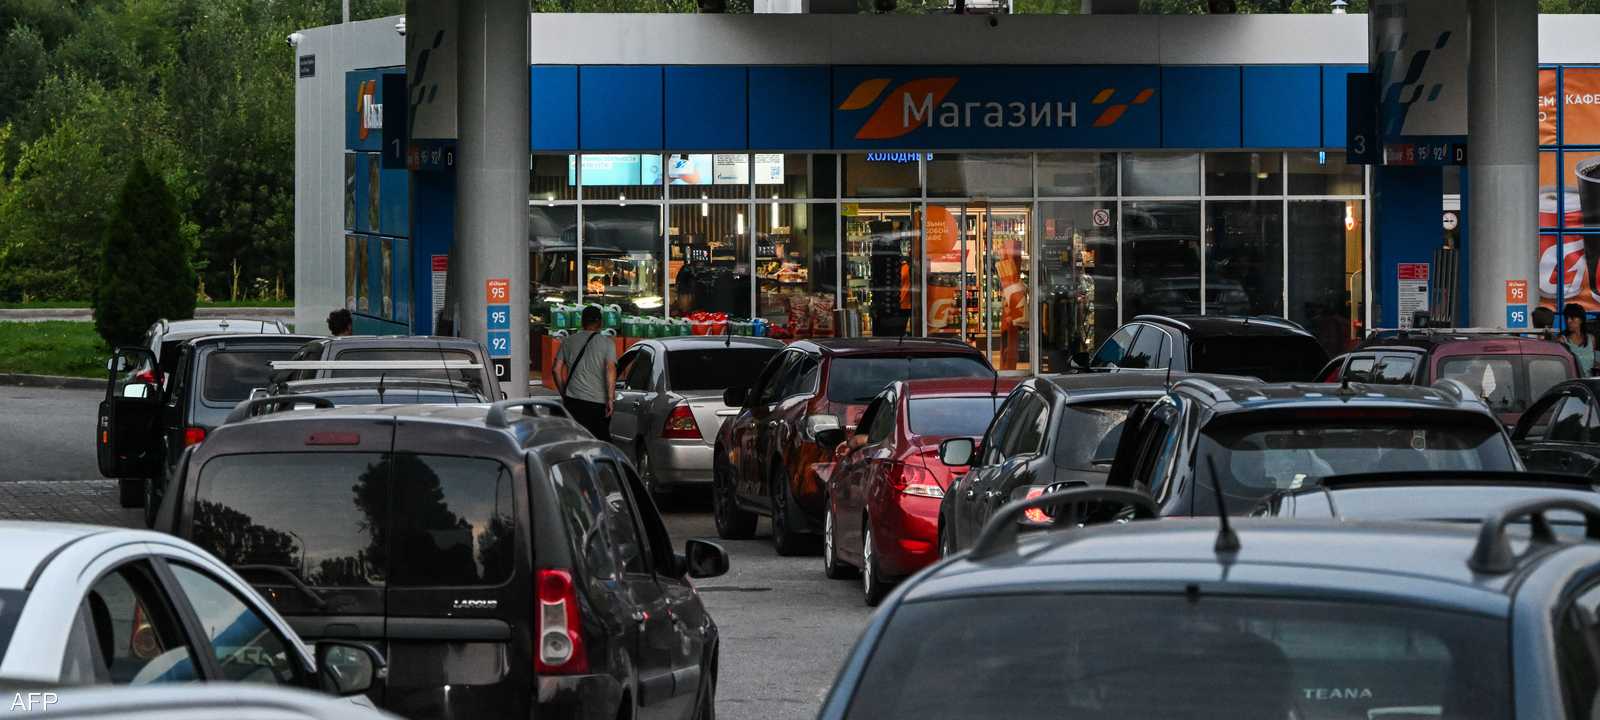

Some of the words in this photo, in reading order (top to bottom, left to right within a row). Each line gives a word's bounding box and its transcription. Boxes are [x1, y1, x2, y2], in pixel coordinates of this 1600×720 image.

[1538, 96, 1555, 107] ЕМ
[903, 92, 1077, 128] Магазин
[391, 138, 401, 158] 1
[1353, 135, 1366, 154] 3
[1456, 148, 1464, 161] D
[491, 287, 505, 299] 95
[1511, 288, 1524, 299] 95
[491, 311, 506, 323] 95
[1511, 311, 1524, 322] 95
[492, 337, 507, 350] 92
[495, 364, 504, 377] D
[1303, 687, 1373, 700] TEANA
